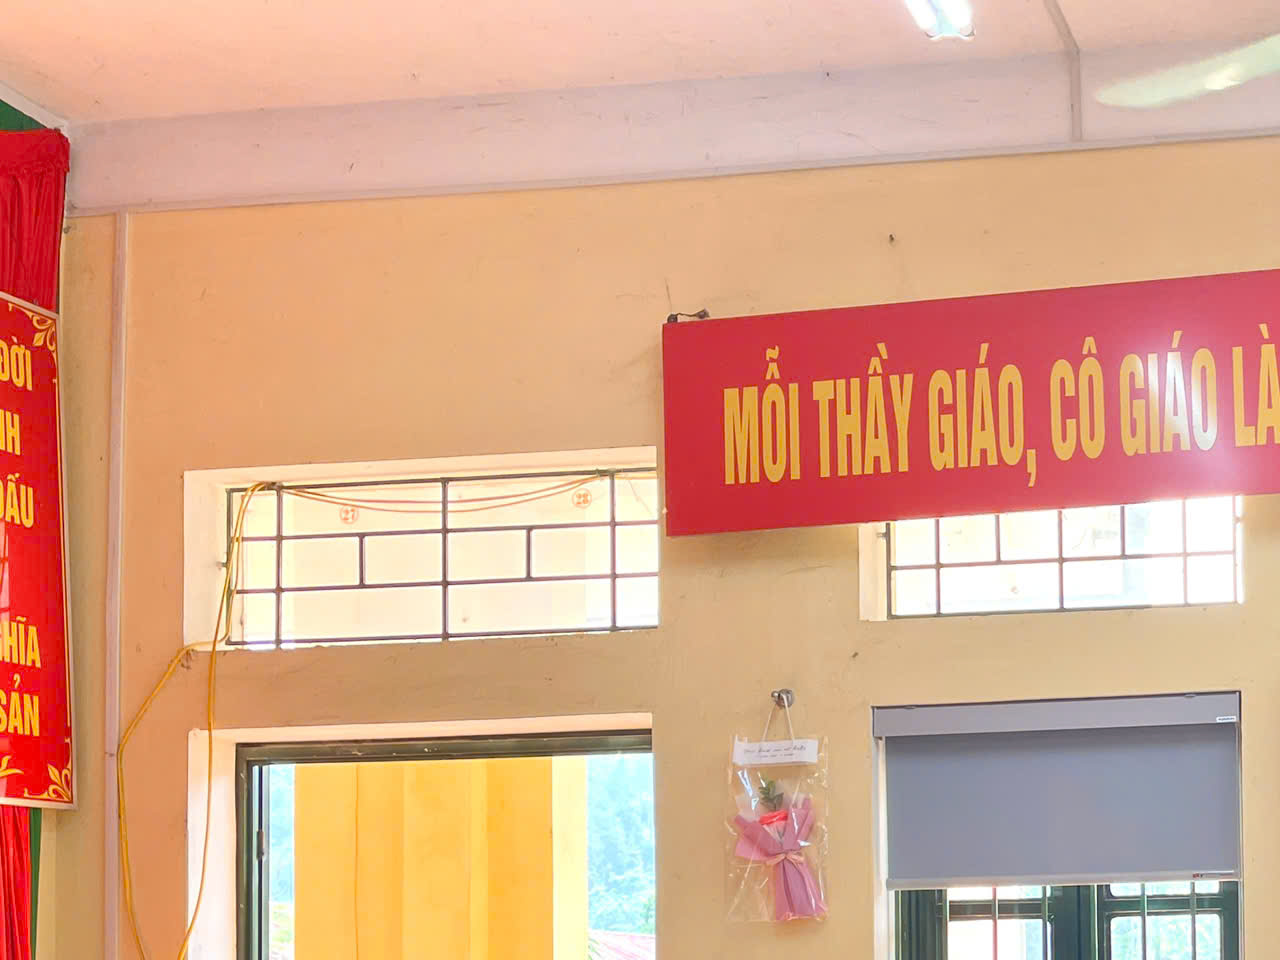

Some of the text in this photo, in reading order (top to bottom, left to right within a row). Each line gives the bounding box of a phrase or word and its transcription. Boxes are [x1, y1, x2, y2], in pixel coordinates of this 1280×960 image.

[724, 345, 800, 485] MỖI
[812, 342, 913, 478] THẦY
[928, 343, 1037, 487] GIÁO,
[1050, 336, 1105, 461] CÔ
[1119, 330, 1218, 456] GIÁO
